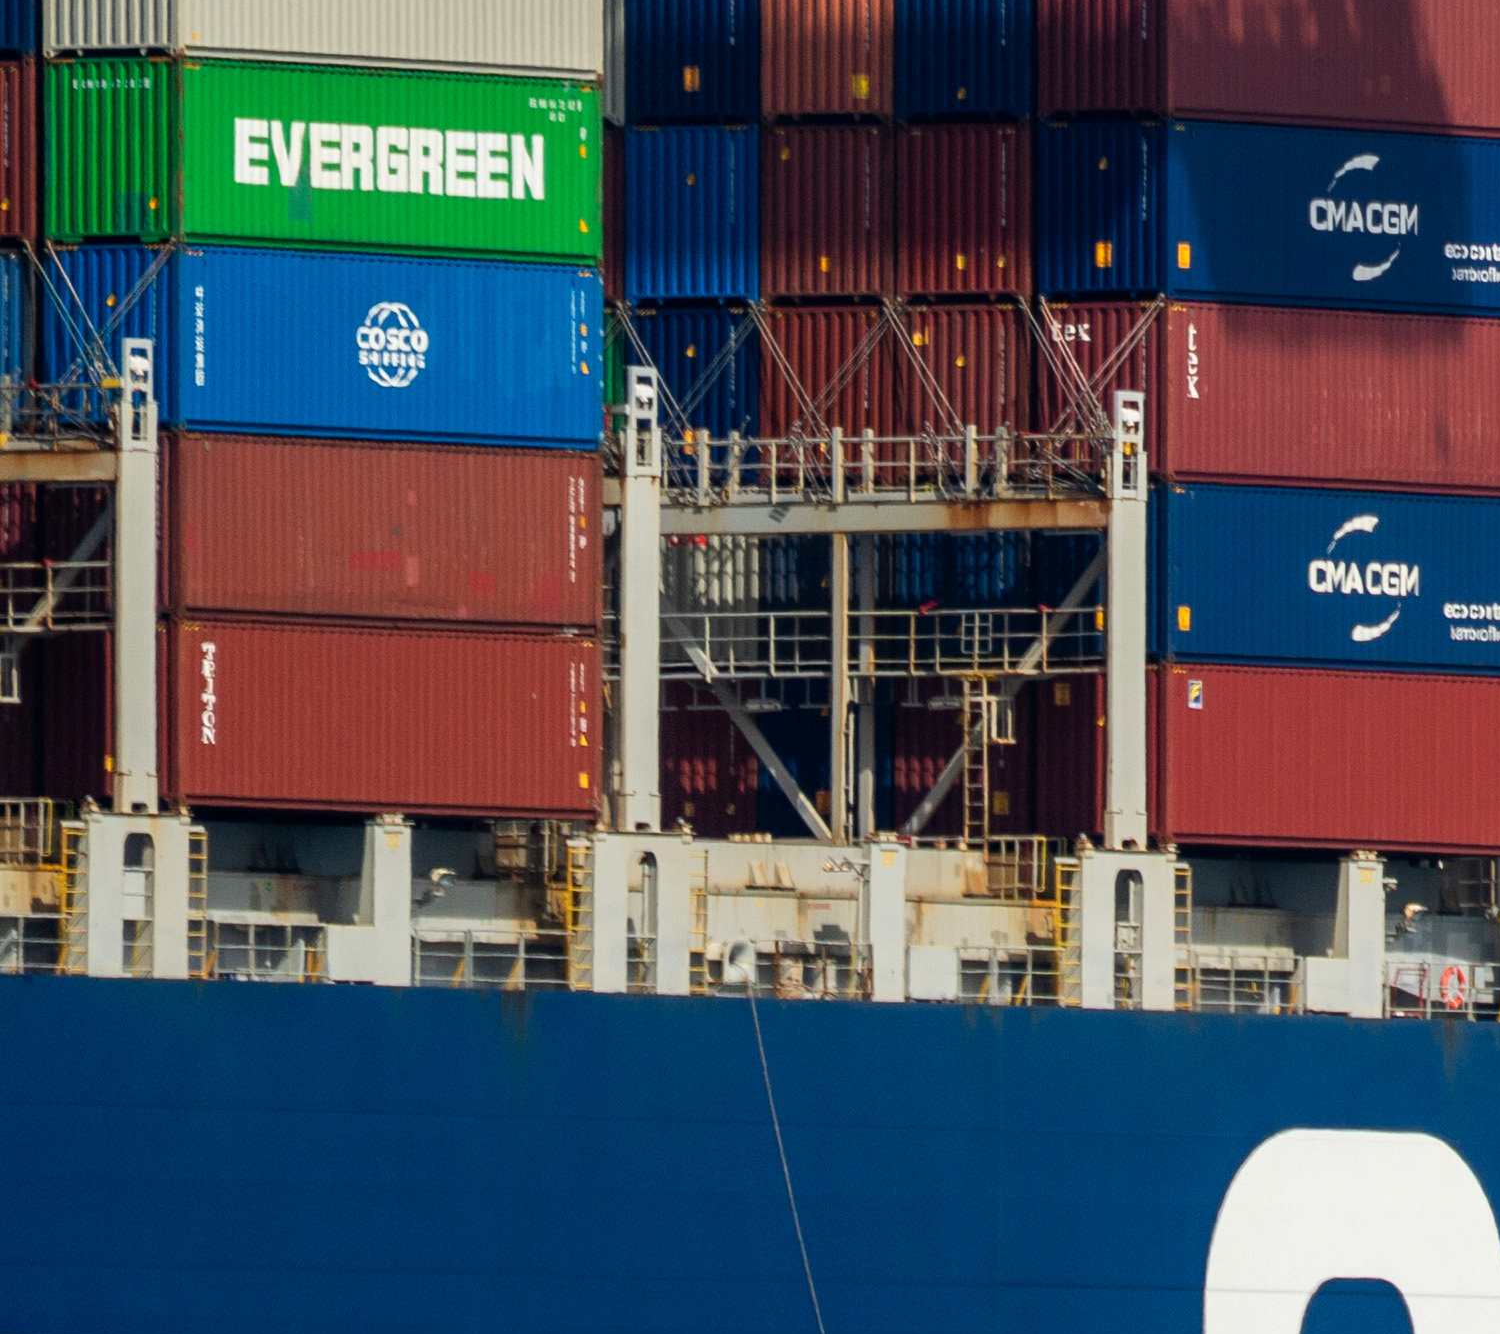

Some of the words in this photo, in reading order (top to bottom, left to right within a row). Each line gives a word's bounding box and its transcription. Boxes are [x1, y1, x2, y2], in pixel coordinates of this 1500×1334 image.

[233, 116, 546, 202] EVERGREEN
[1309, 198, 1365, 234] CMA
[1366, 202, 1419, 237] CGM
[355, 326, 430, 354] COSCO
[1308, 559, 1364, 595] CMA
[1365, 562, 1420, 598] CGM
